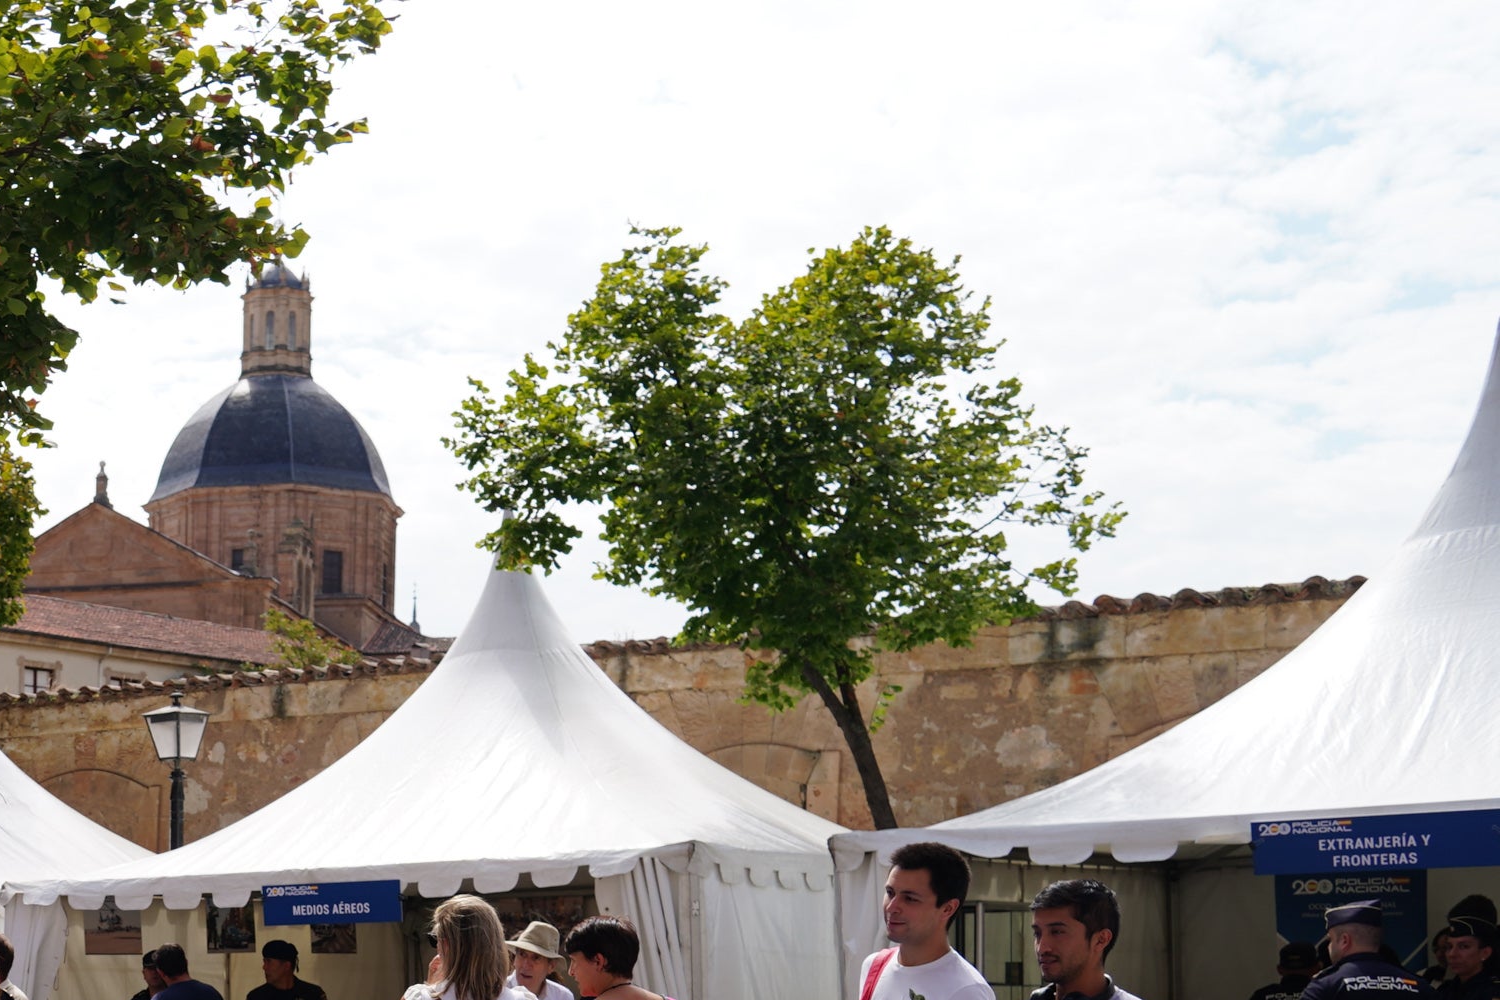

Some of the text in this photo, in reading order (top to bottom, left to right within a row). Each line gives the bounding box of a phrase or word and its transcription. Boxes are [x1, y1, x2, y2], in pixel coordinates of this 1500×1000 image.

[1292, 826, 1352, 834] NACIONAL
[1318, 832, 1431, 851] EXTRANJERÍA Y
[1333, 852, 1418, 867] FRONTERAS
[1335, 884, 1410, 894] NACIONAL
[292, 901, 370, 916] MEDIOS AÉREOS
[1346, 982, 1419, 993] NACIONAL
